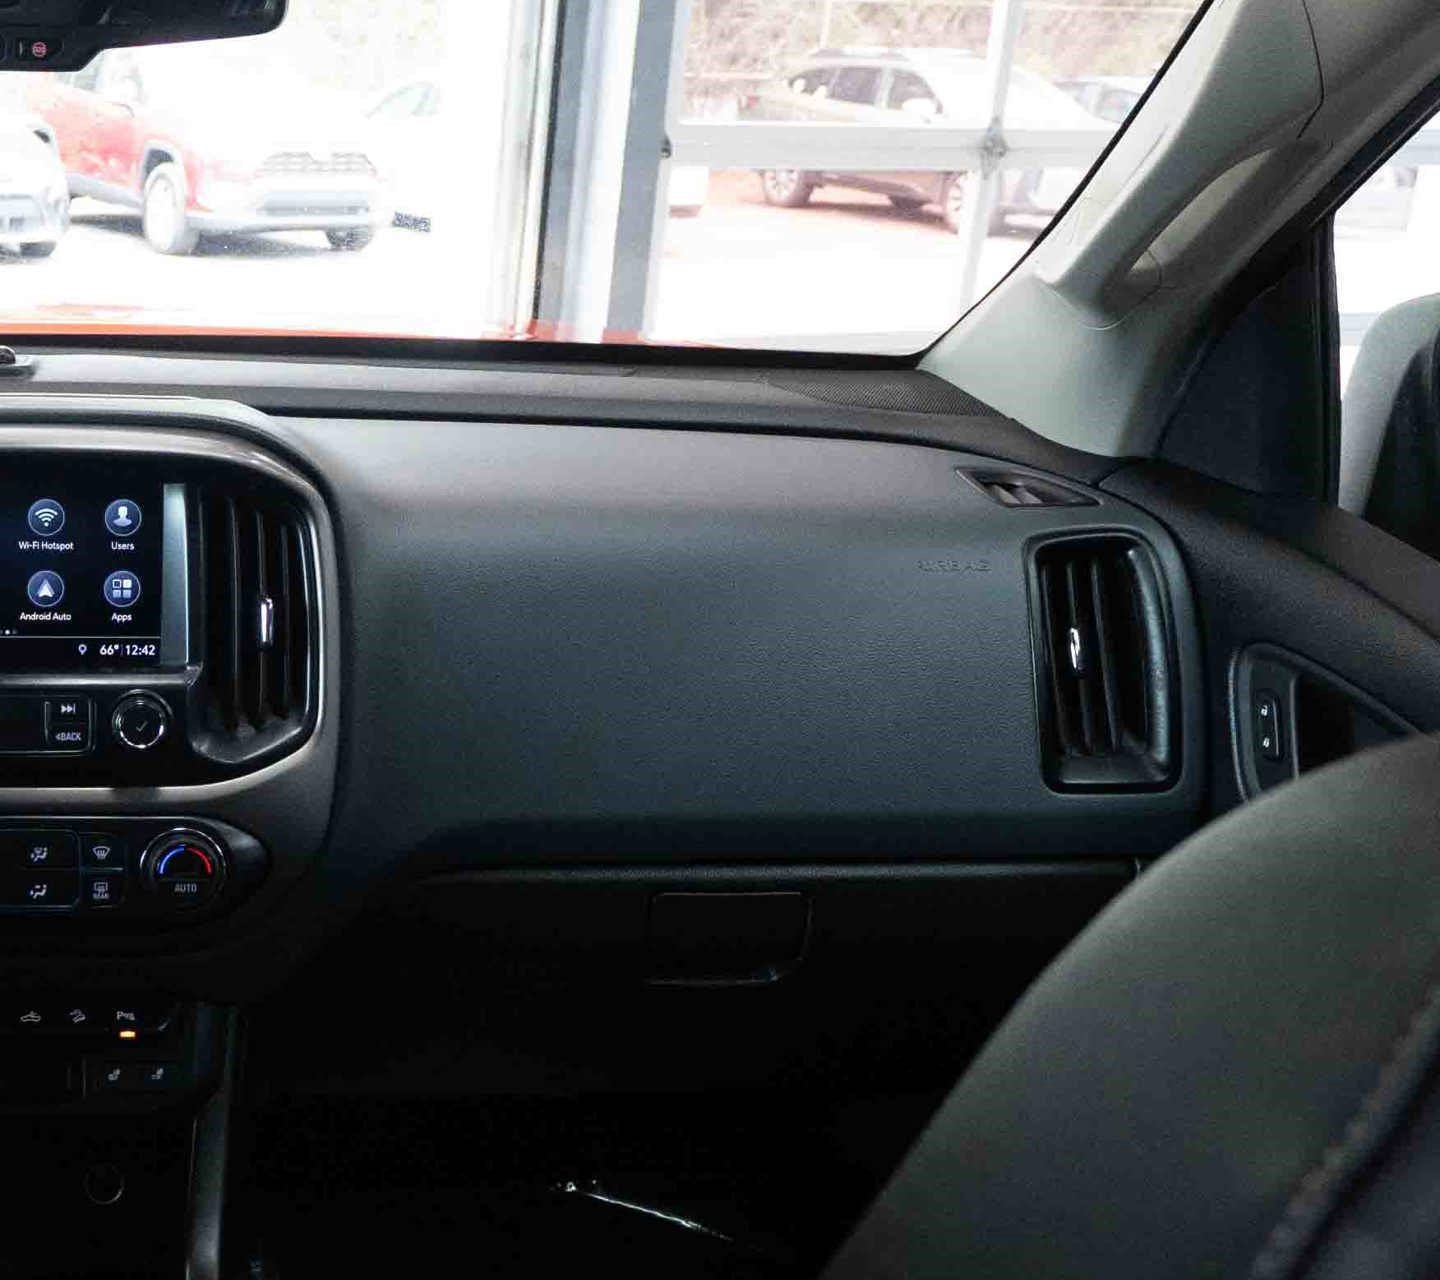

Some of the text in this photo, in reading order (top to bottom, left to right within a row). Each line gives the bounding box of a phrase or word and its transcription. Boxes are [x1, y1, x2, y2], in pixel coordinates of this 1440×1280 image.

[18, 540, 75, 552] Wi-Fi Hotspot
[111, 541, 135, 551] Users
[19, 612, 72, 621] Android Auto
[111, 613, 133, 623] Apps
[125, 644, 156, 656] 12:42
[60, 731, 81, 741] BACK
[173, 882, 198, 893] AUTO
